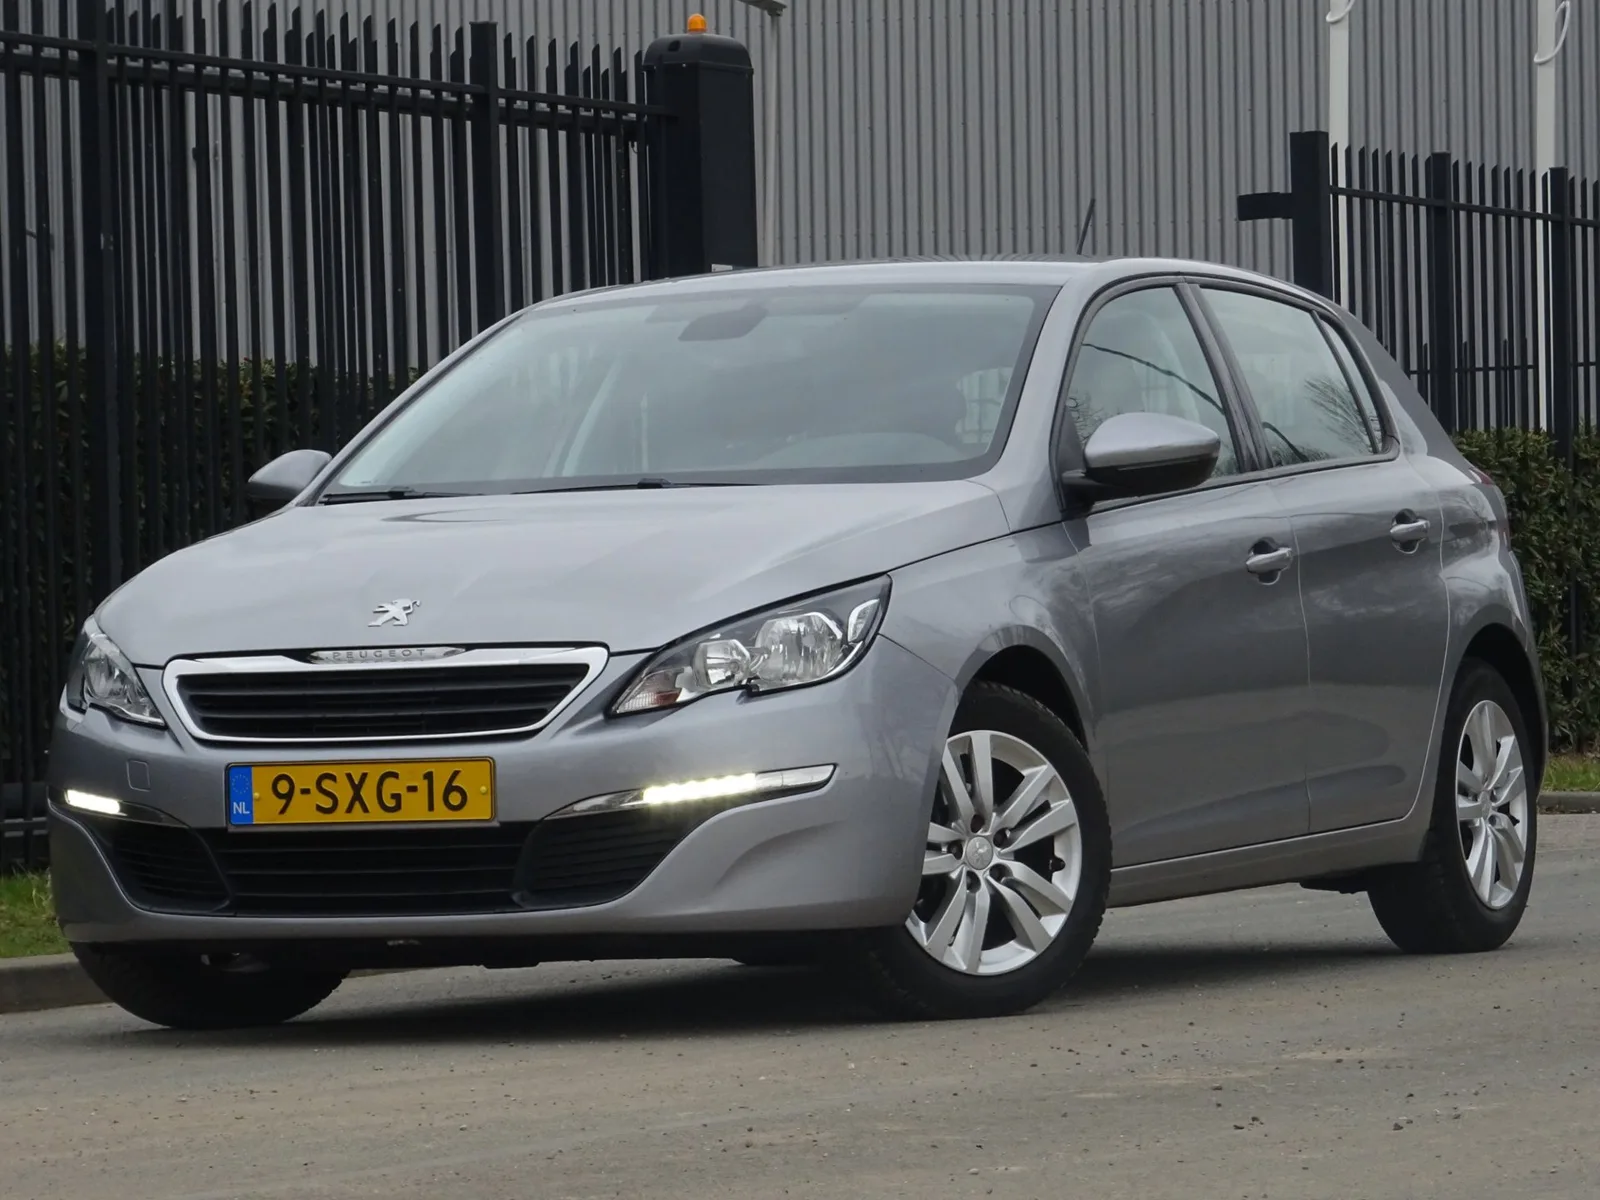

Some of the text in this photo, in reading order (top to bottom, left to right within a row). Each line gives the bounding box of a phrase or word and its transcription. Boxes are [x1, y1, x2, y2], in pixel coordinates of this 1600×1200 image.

[332, 649, 426, 660] PEUGEOT
[271, 769, 468, 815] 9-SXG-16
[233, 801, 250, 815] NL
